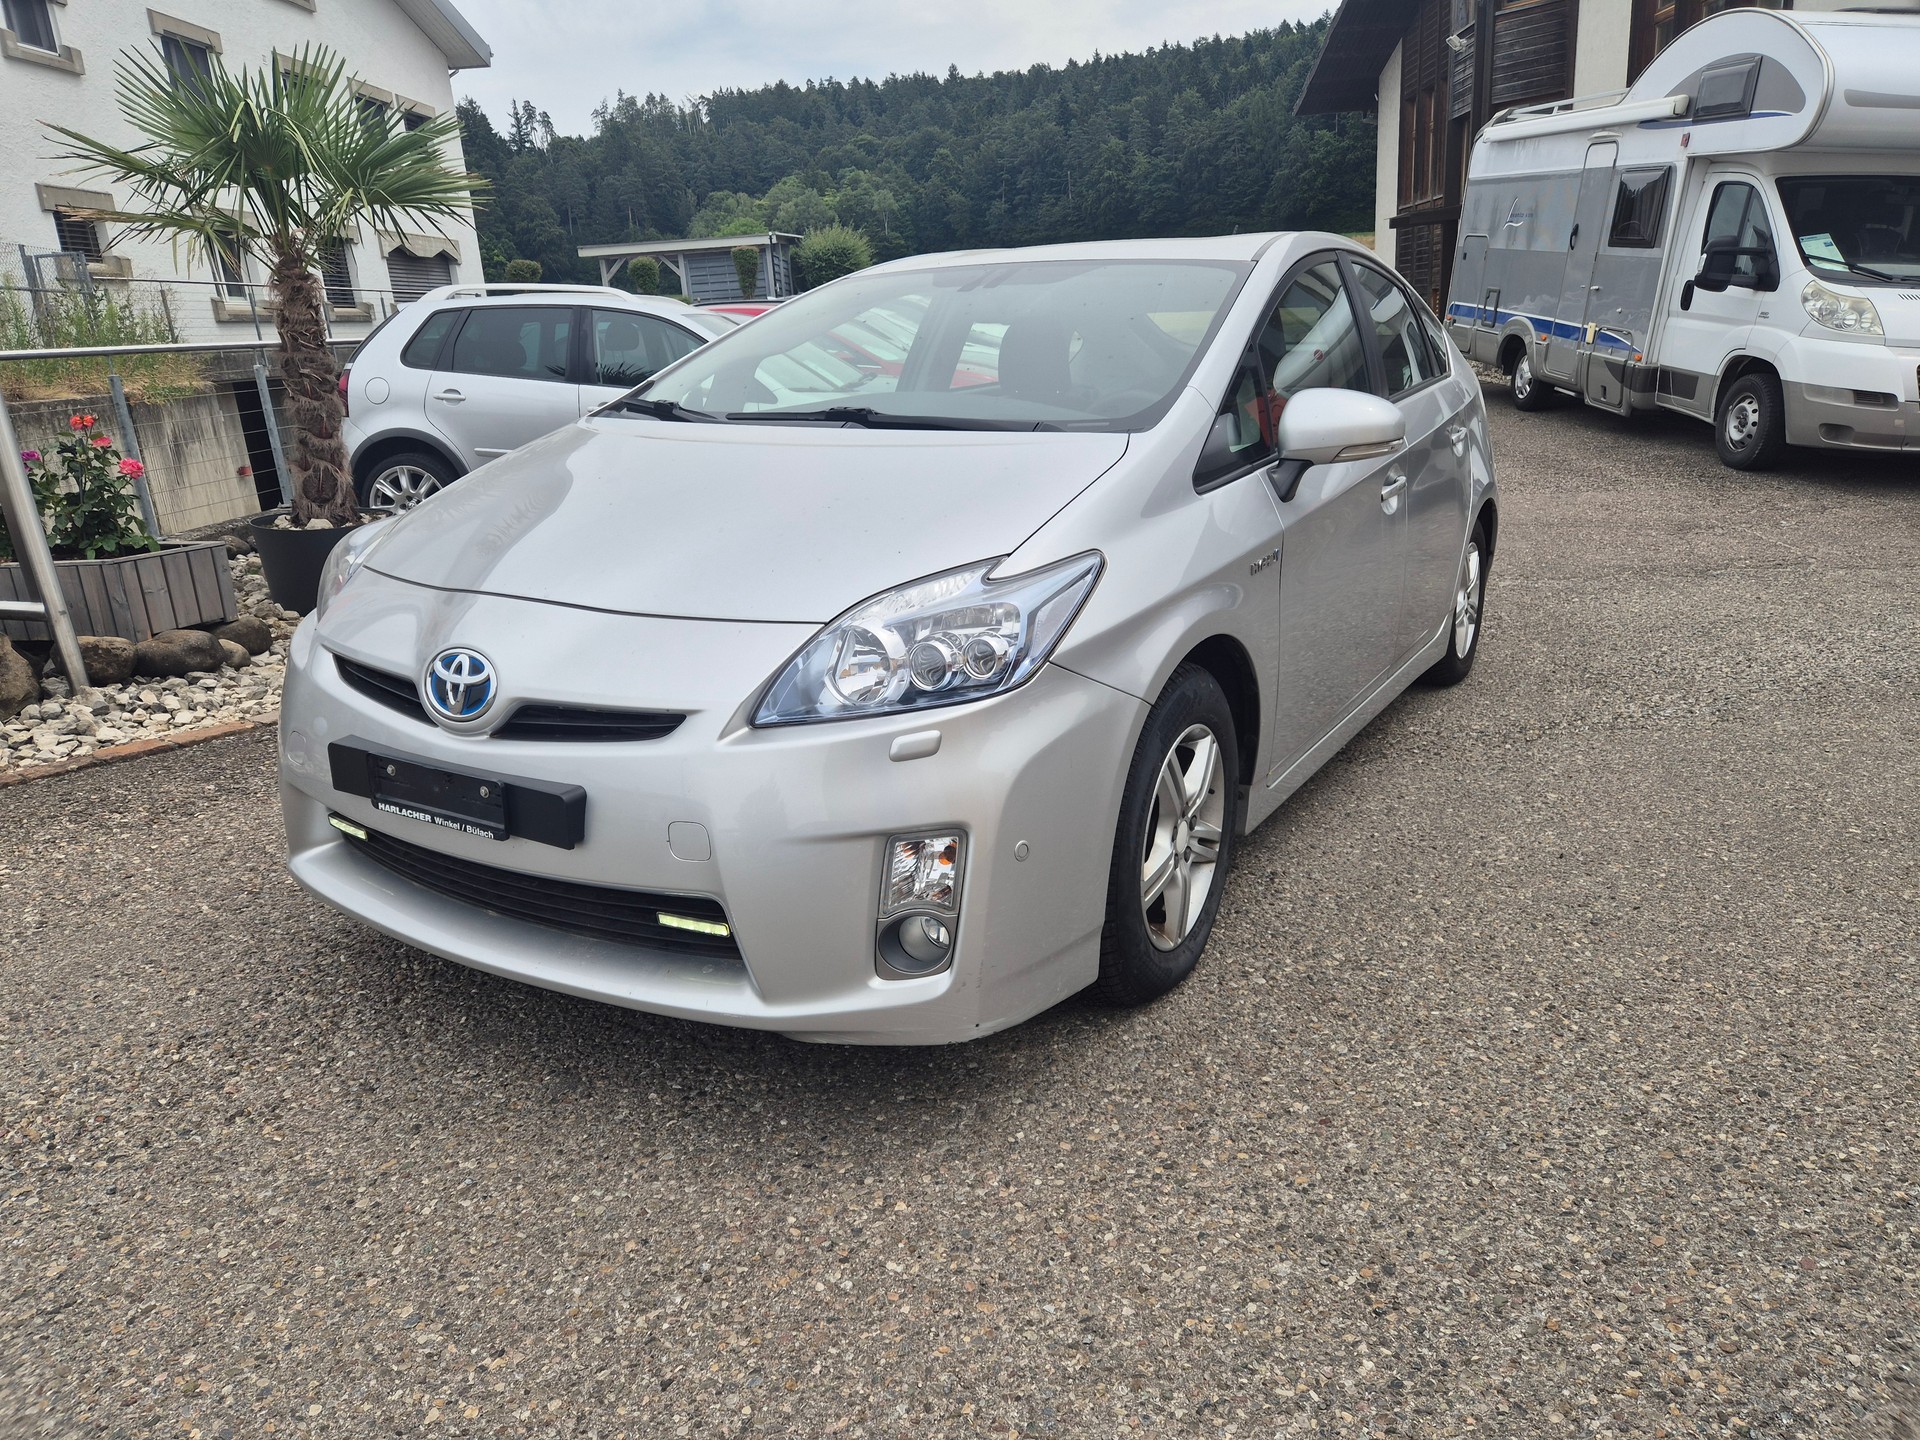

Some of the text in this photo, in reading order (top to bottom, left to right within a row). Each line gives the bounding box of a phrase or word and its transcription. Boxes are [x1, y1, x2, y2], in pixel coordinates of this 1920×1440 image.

[378, 803, 494, 840] HARLACHER Winkel / Bülach
